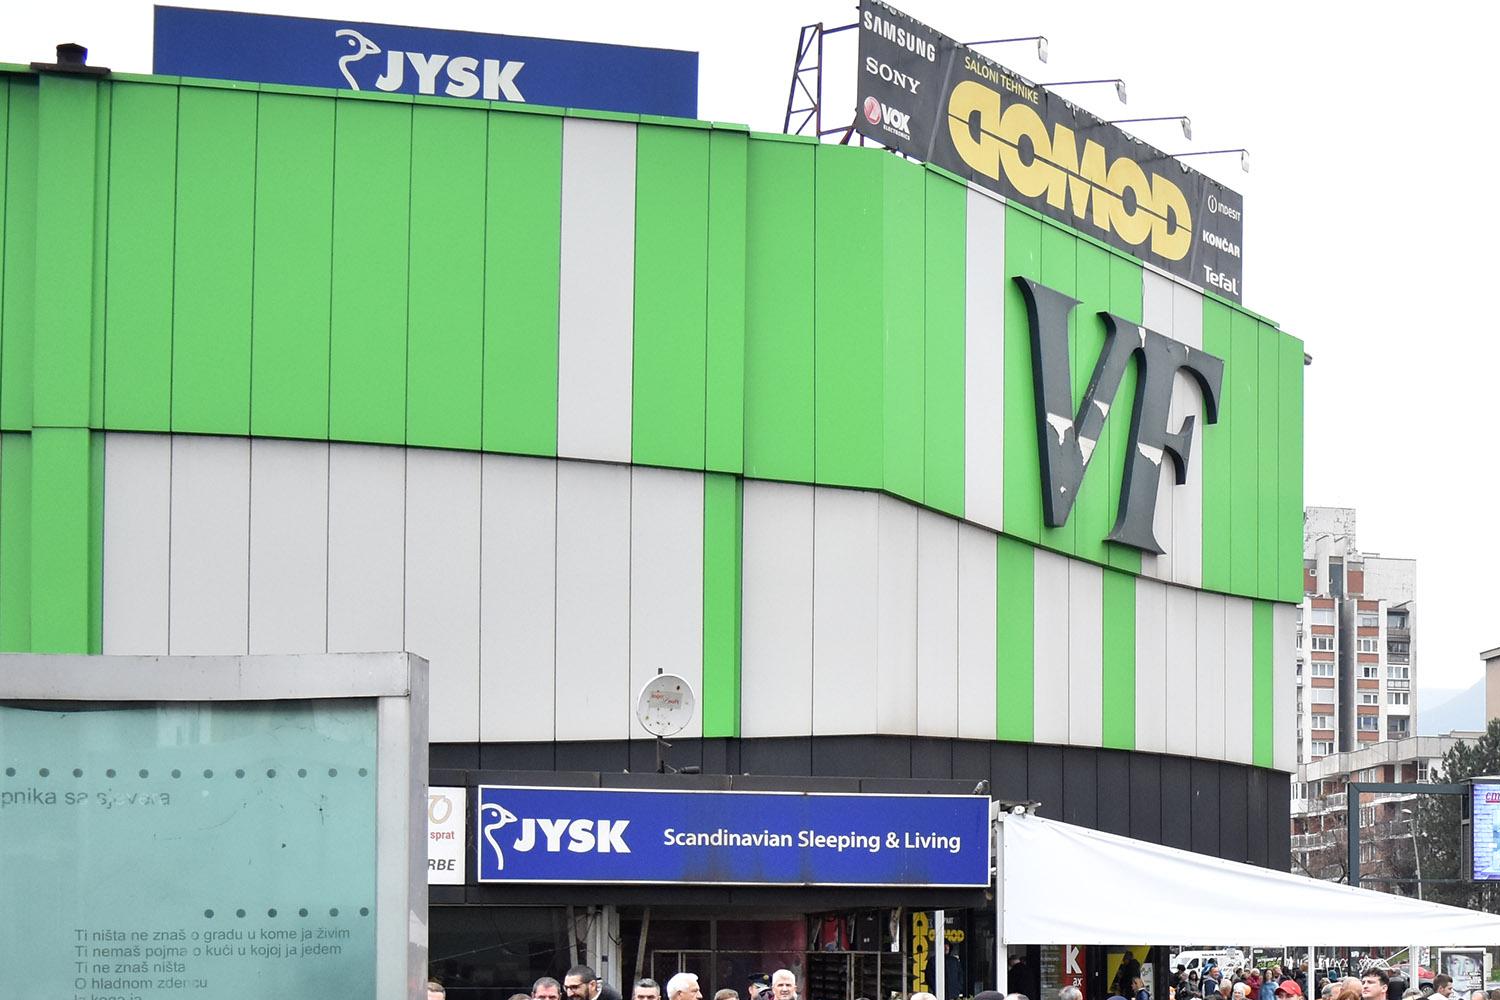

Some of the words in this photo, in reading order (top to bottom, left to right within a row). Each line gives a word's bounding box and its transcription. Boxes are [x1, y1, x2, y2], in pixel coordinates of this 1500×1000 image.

[863, 10, 936, 62] SAMSUNG
[375, 50, 526, 102] JYSK
[865, 56, 921, 95] SONY
[964, 56, 999, 84] SALONI
[1000, 74, 1040, 105] TEHNIKE
[881, 103, 911, 135] VOX
[1203, 229, 1240, 258] KONČAR
[1203, 264, 1239, 296] Tefal
[430, 831, 455, 842] sprat
[513, 818, 631, 853] JYSK
[663, 828, 793, 848] Scandinavian
[798, 830, 881, 853] Sleeping
[885, 832, 899, 849] &
[904, 832, 961, 853] Living
[75, 929, 88, 941] Ti
[92, 929, 126, 941] ništa
[131, 931, 148, 941] ne
[152, 928, 186, 941] znaš
[203, 928, 243, 944] gradu
[247, 931, 256, 940] u
[260, 928, 297, 940] kome
[300, 928, 313, 944] ja
[316, 926, 351, 940] živim
[75, 945, 88, 958] Ti
[92, 945, 141, 958] nemaš
[145, 946, 188, 961] pojma
[206, 943, 234, 957] kući
[238, 947, 246, 956] u
[250, 943, 282, 960] kojoj
[285, 943, 297, 959] ja
[300, 942, 342, 958] jedem
[75, 962, 88, 974] Ti
[93, 964, 110, 974] ne
[115, 961, 148, 974] znaš
[153, 961, 186, 974] ništa
[75, 978, 87, 990] O
[91, 977, 153, 990] hladnom
